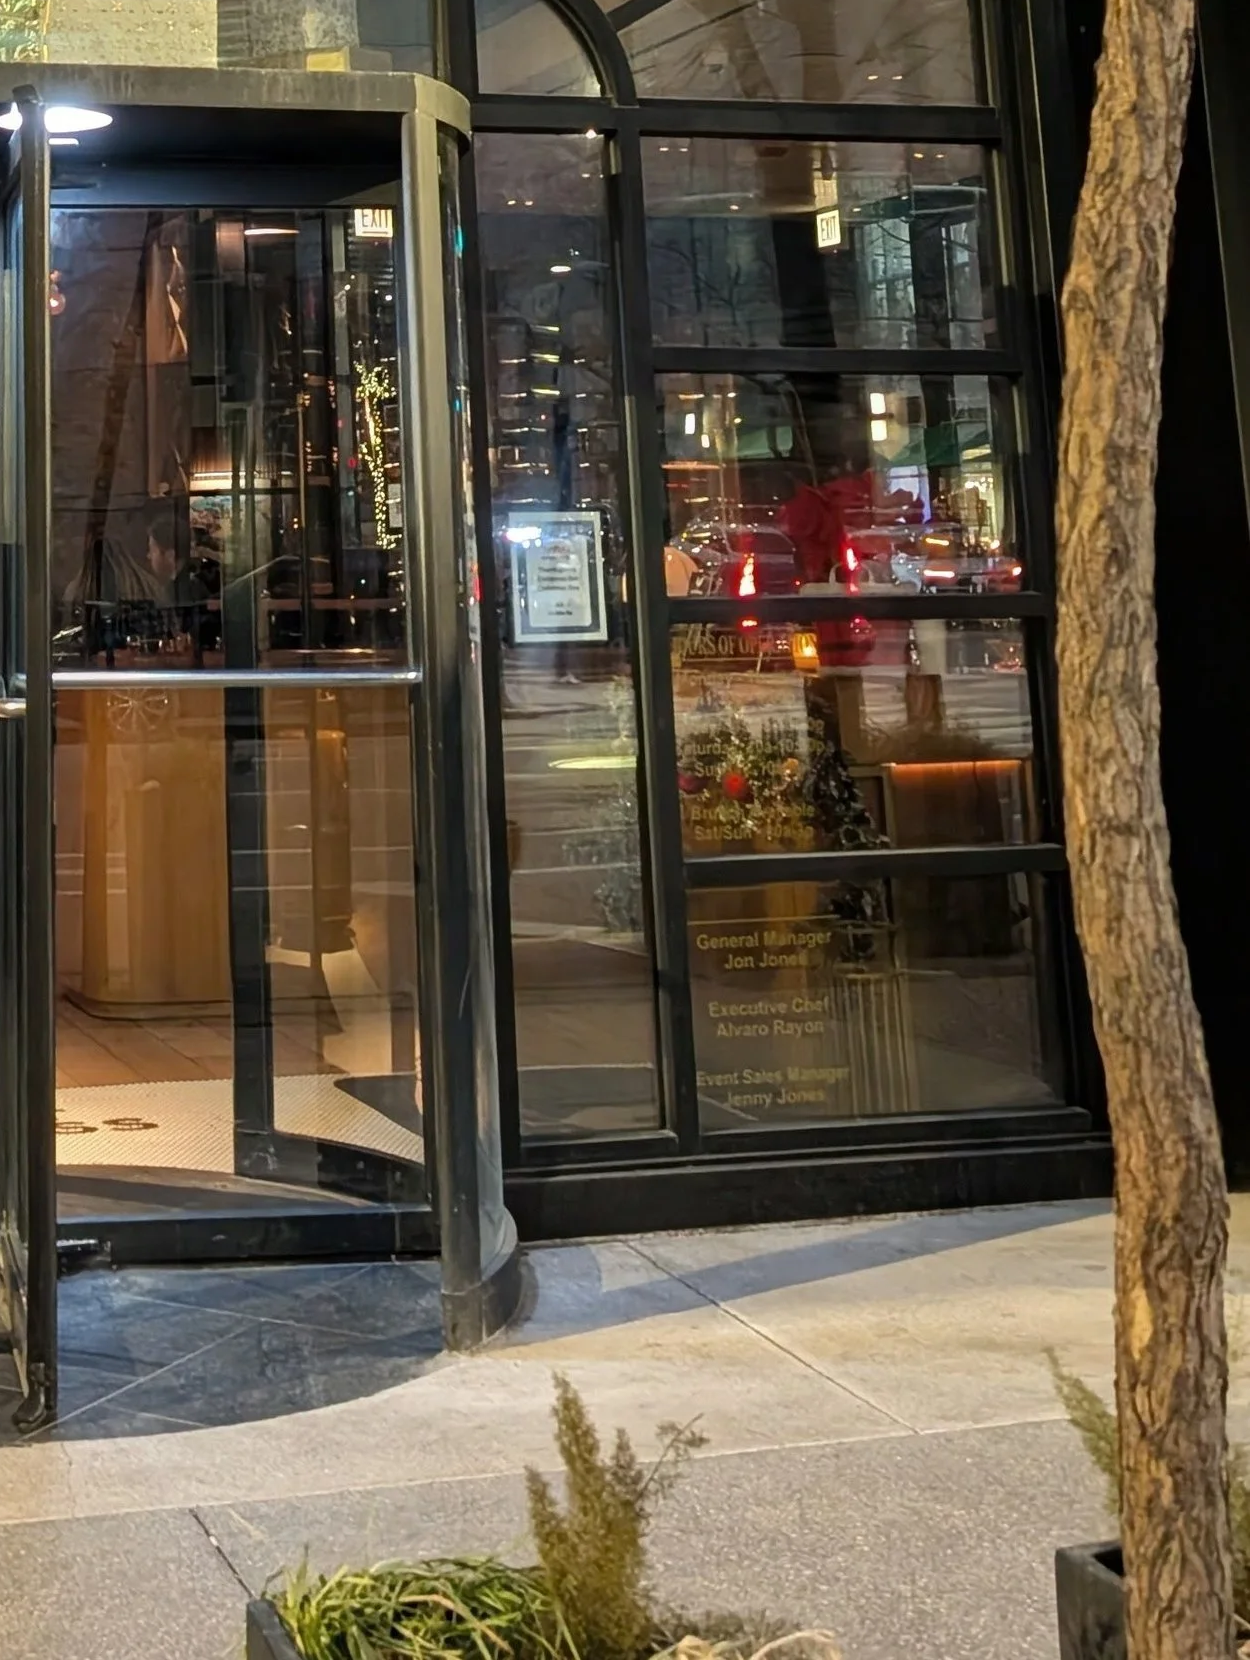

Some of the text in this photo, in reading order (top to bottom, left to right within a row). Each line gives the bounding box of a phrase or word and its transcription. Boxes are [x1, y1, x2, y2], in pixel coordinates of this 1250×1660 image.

[820, 215, 836, 241] EXIT
[696, 930, 832, 950] General Manager
[724, 951, 810, 970] Jon Jones
[708, 996, 830, 1018] Executive Chef
[716, 1019, 825, 1038] Alvaro Rayon
[696, 1070, 739, 1087] Event
[742, 1068, 783, 1084] Sales
[727, 1088, 826, 1108] Jenny Jones
